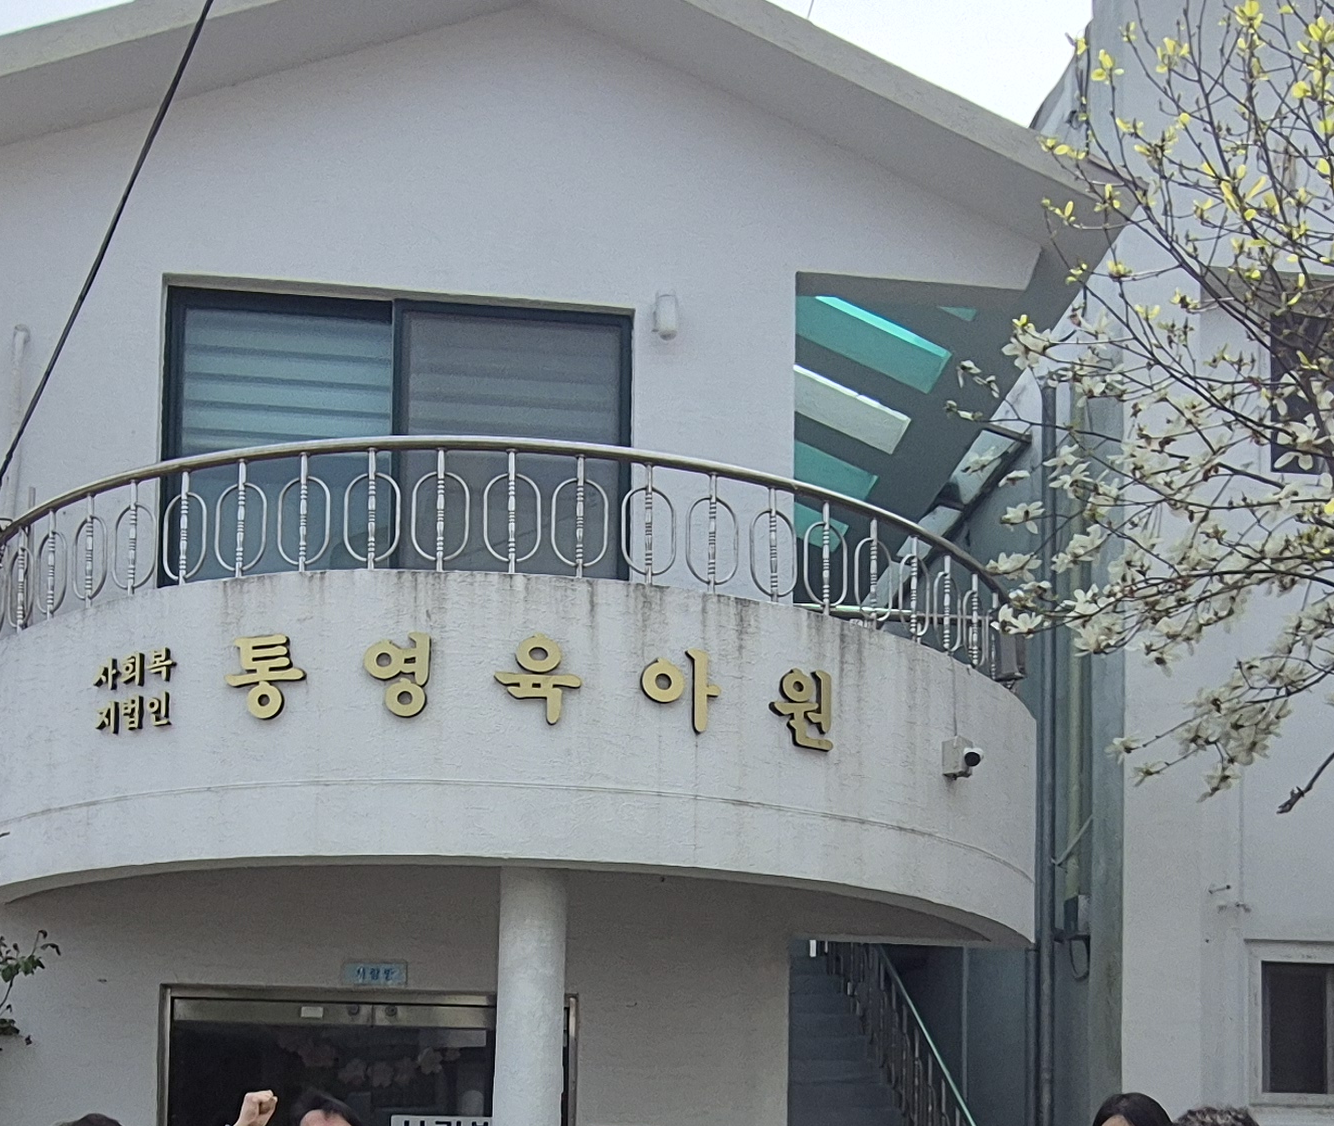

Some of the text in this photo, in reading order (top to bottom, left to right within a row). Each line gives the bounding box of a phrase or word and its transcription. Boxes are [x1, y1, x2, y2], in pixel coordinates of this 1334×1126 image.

[92, 646, 177, 690] 사회복
[95, 691, 172, 735] 지법인
[224, 632, 834, 752] 통영육아원
